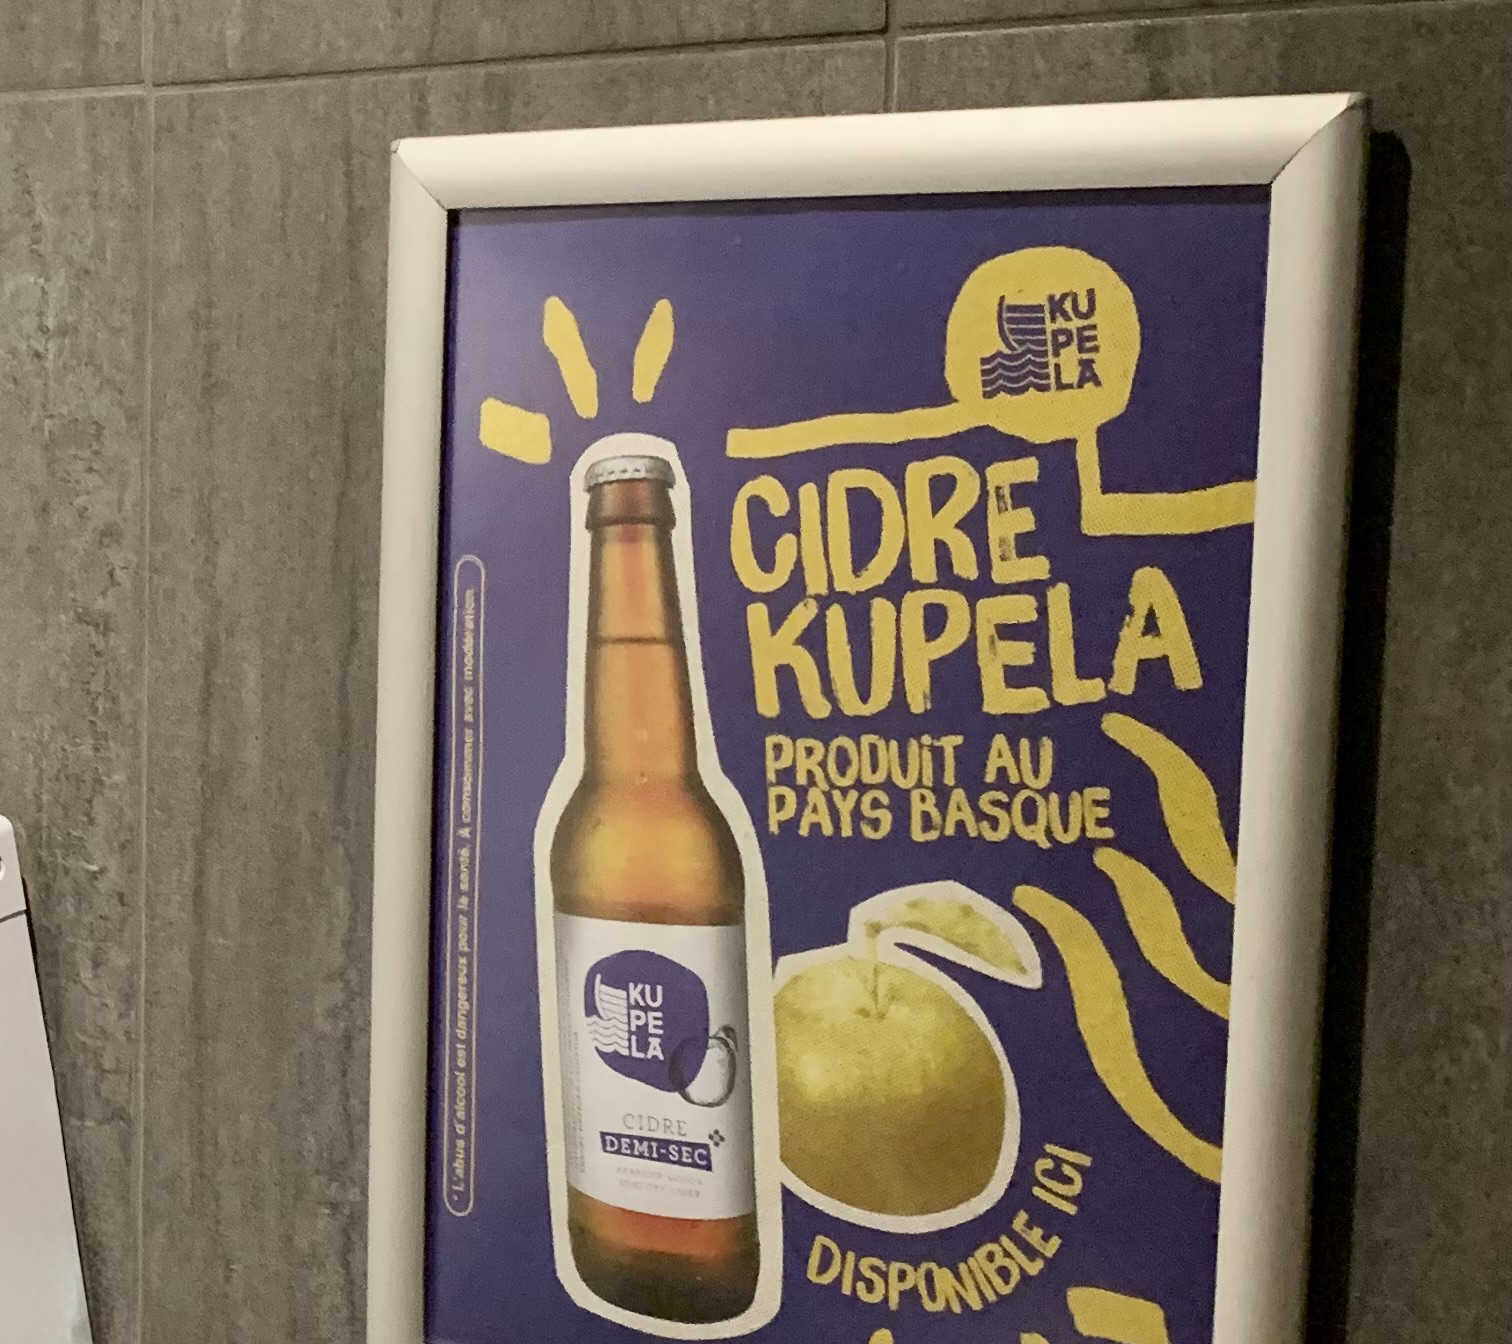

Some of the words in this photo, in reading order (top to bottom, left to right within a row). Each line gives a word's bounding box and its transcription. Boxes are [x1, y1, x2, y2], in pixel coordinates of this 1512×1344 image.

[1048, 288, 1096, 322] KU
[1049, 325, 1101, 358] PE
[730, 457, 1049, 596] CIDRE
[746, 567, 1203, 719] KUPELA
[986, 736, 1055, 788] AU
[768, 785, 891, 840] PAYS
[910, 785, 1115, 845] BASQUE
[627, 982, 663, 1008] KU
[629, 1010, 664, 1035] PE
[630, 1035, 665, 1061] LA
[621, 1112, 688, 1137] CIDRE
[604, 1134, 709, 1167] DEMI-SEC
[1033, 1143, 1093, 1214] ICI
[807, 1215, 1063, 1314] DISPONIBLE
